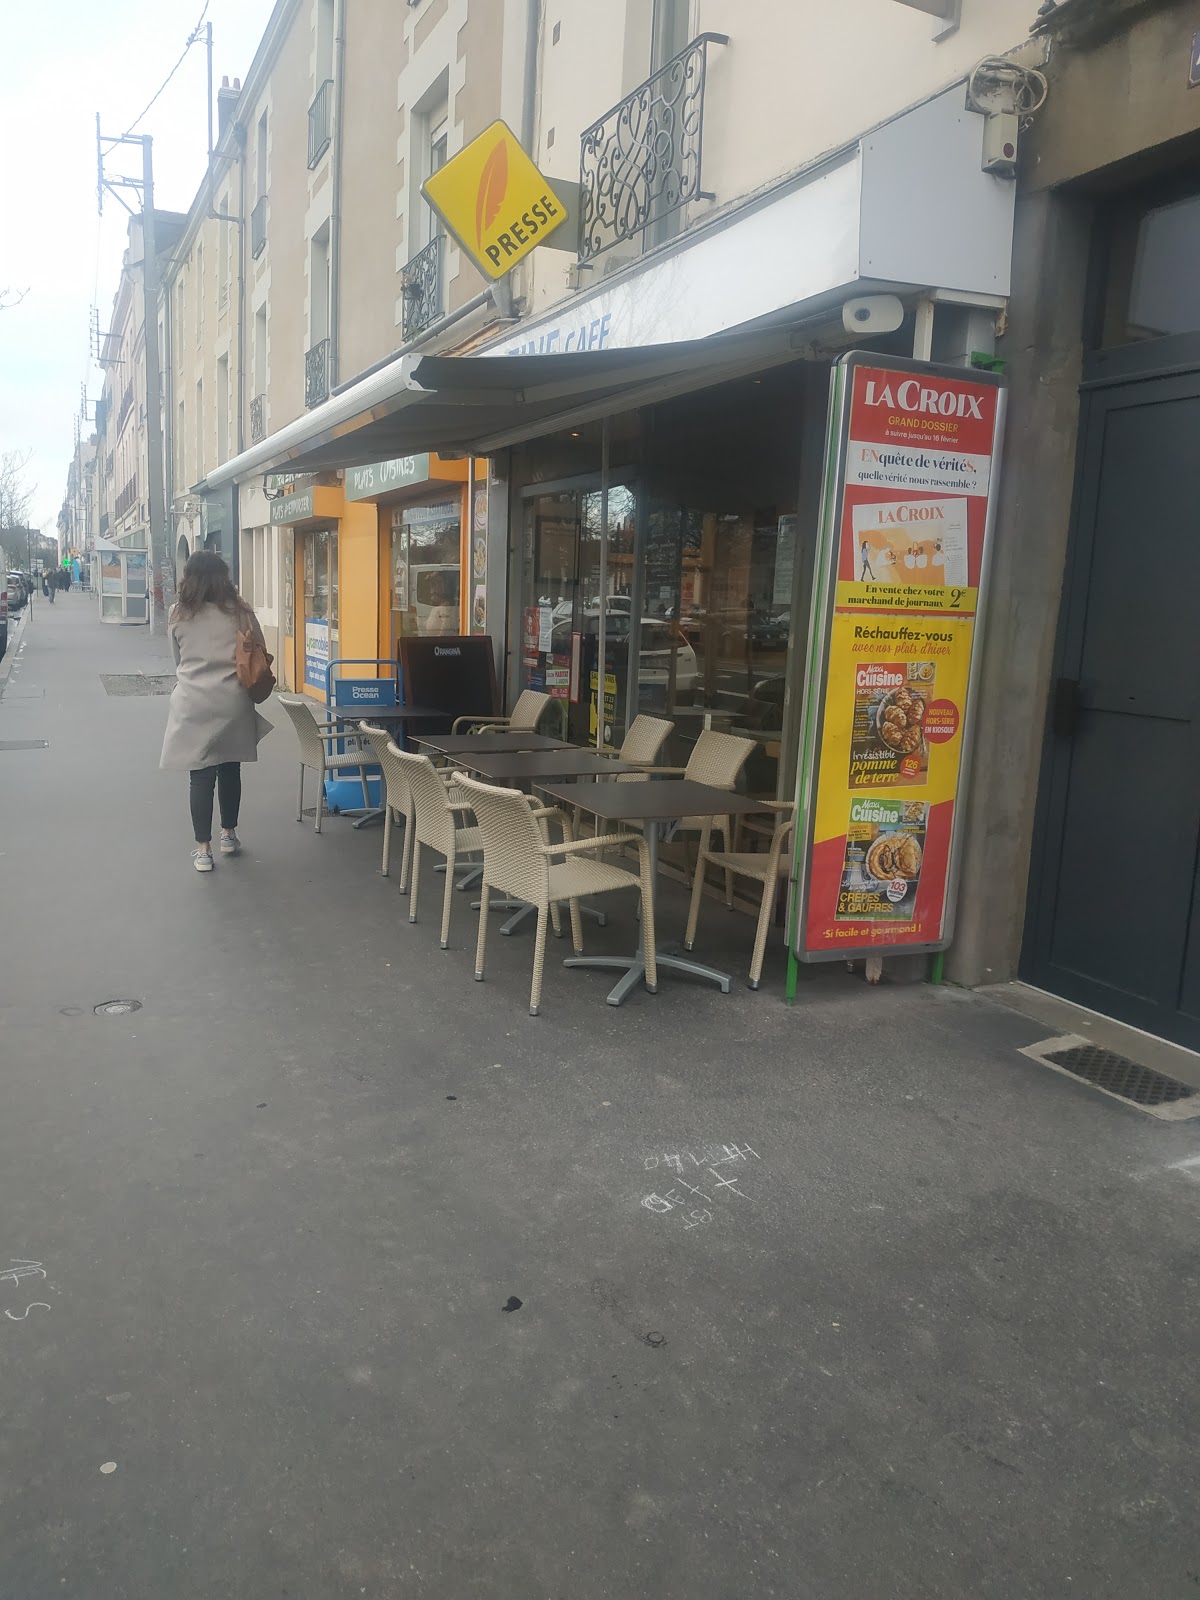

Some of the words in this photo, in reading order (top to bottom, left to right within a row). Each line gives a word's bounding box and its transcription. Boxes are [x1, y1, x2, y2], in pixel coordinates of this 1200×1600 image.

[485, 195, 558, 267] PRESSE
[888, 416, 920, 429] GRAND
[921, 418, 959, 433] DOSSIER
[891, 430, 907, 438] suivre
[907, 431, 932, 442] jusqu'au
[932, 434, 940, 442] 16
[941, 434, 959, 444] février
[861, 448, 914, 467] ENquête
[915, 455, 930, 468] de
[858, 470, 884, 482] quelle
[884, 471, 908, 483] vérité
[909, 475, 929, 485] nous
[930, 476, 970, 489] rassemble
[865, 584, 877, 594] En
[879, 586, 901, 595] vente
[902, 586, 922, 596] chez
[923, 588, 945, 597] votre
[848, 596, 894, 607] marchand
[895, 597, 905, 607] de
[905, 597, 944, 609] journaux
[854, 625, 953, 642] Réchauffez-vous
[852, 643, 875, 652] avec
[876, 644, 891, 653] nos
[894, 642, 919, 656] plats
[920, 642, 952, 656] d'hiver
[857, 670, 903, 687] Cuisine
[928, 708, 954, 716] NOUVEAU
[924, 726, 932, 734] EN
[932, 726, 955, 734] KIOSQUE
[852, 748, 896, 760] Irrésistible
[850, 760, 898, 775] pomme
[905, 758, 919, 769] 126
[854, 770, 871, 785] de
[871, 772, 899, 784] terre
[861, 799, 880, 809] Maxi
[851, 805, 898, 823] Cuisine
[890, 880, 906, 892] 103
[840, 889, 880, 903] CRÊPES
[838, 902, 846, 912] &
[848, 902, 894, 913] GAUFRES
[835, 927, 859, 938] facile
[860, 927, 869, 936] et
[871, 923, 916, 937] gourmand
